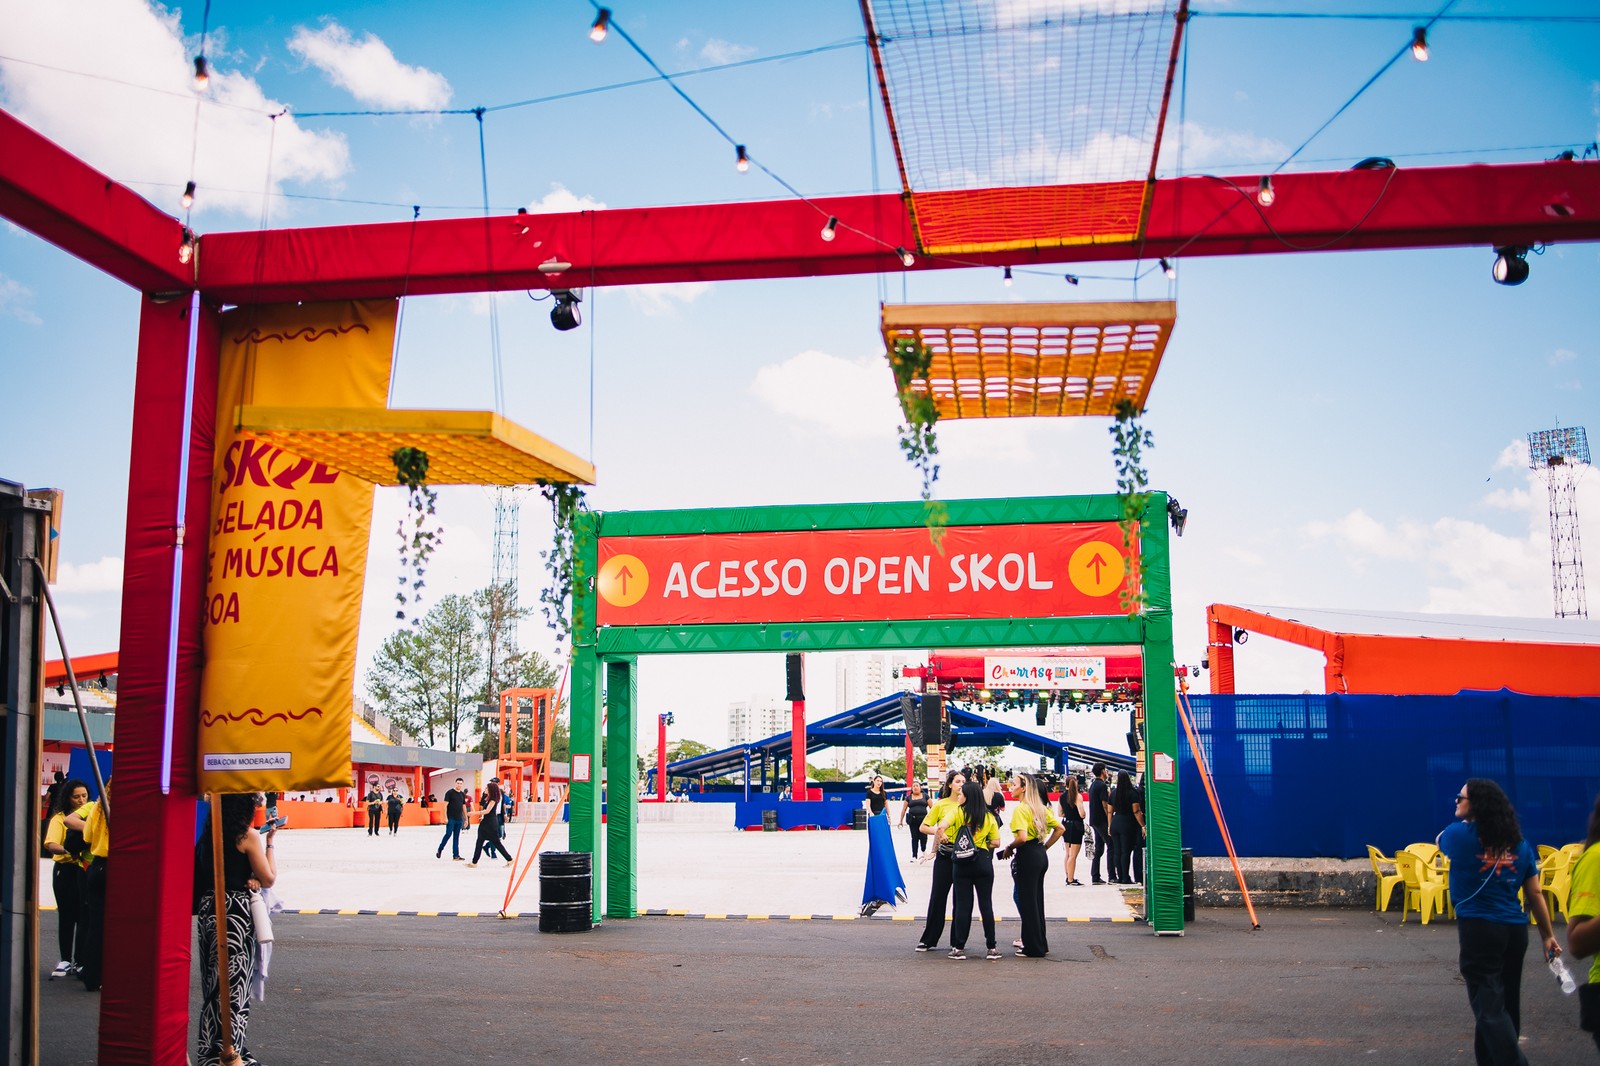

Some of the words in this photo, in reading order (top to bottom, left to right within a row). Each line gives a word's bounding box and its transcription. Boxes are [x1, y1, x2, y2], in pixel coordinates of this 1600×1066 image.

[219, 439, 341, 494] SKOL
[222, 532, 338, 579] MÚSICA
[663, 558, 807, 598] ACESSO
[823, 555, 931, 595] OPEN
[948, 551, 1054, 593] SKOL
[207, 758, 221, 766] BEBA
[221, 758, 237, 766] COM
[238, 756, 285, 766] MODERAÇÃO
